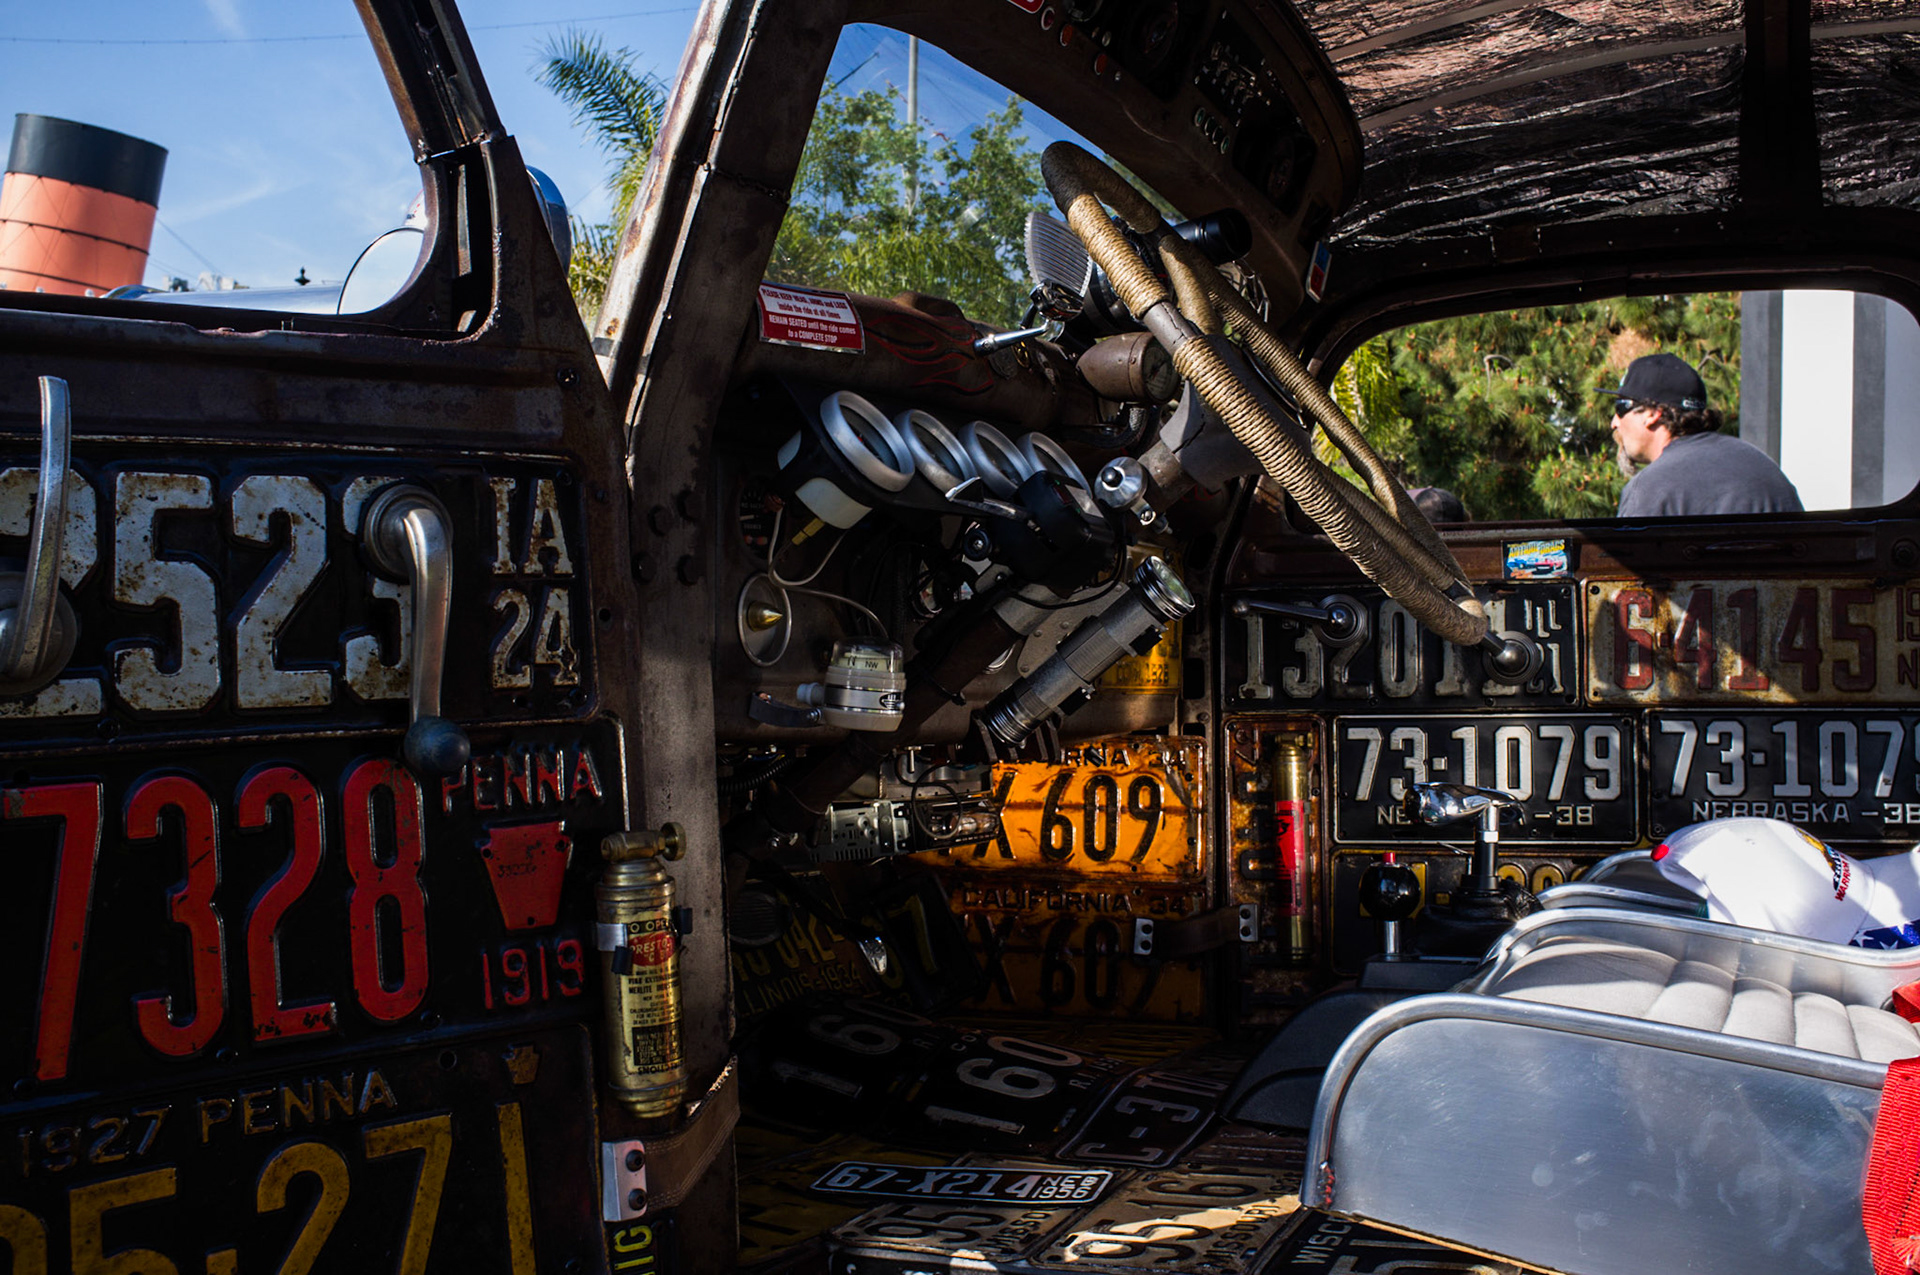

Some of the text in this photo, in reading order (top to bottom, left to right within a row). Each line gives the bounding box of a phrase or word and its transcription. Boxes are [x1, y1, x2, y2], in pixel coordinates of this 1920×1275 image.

[794, 304, 802, 312] the
[803, 305, 813, 315] ride
[824, 300, 834, 308] and
[769, 314, 856, 335] REMAIN SEATED until the ride comes
[788, 329, 794, 338] to
[799, 330, 824, 342] COMPLETE
[825, 333, 838, 343] STOP
[489, 476, 575, 576] IA
[1523, 599, 1563, 639] ILL
[491, 586, 581, 690] 24
[847, 656, 857, 667] N
[864, 660, 879, 669] NW
[1346, 724, 1622, 802] 73-1079
[441, 747, 604, 816] PENNA
[1040, 771, 1164, 863] 609
[1692, 801, 1851, 825] NEBRASKA
[963, 887, 1187, 914] CALIFORNIA 34
[3, 757, 425, 1081] 7328
[481, 938, 586, 1011] 1919
[16, 1066, 399, 1179] 1927 PENNA
[824, 1165, 1042, 1198] 67-X214
[1031, 1185, 1090, 1199] 1956
[1041, 1174, 1098, 1188] NEB
[1199, 1203, 1281, 1268] MISSOURI
